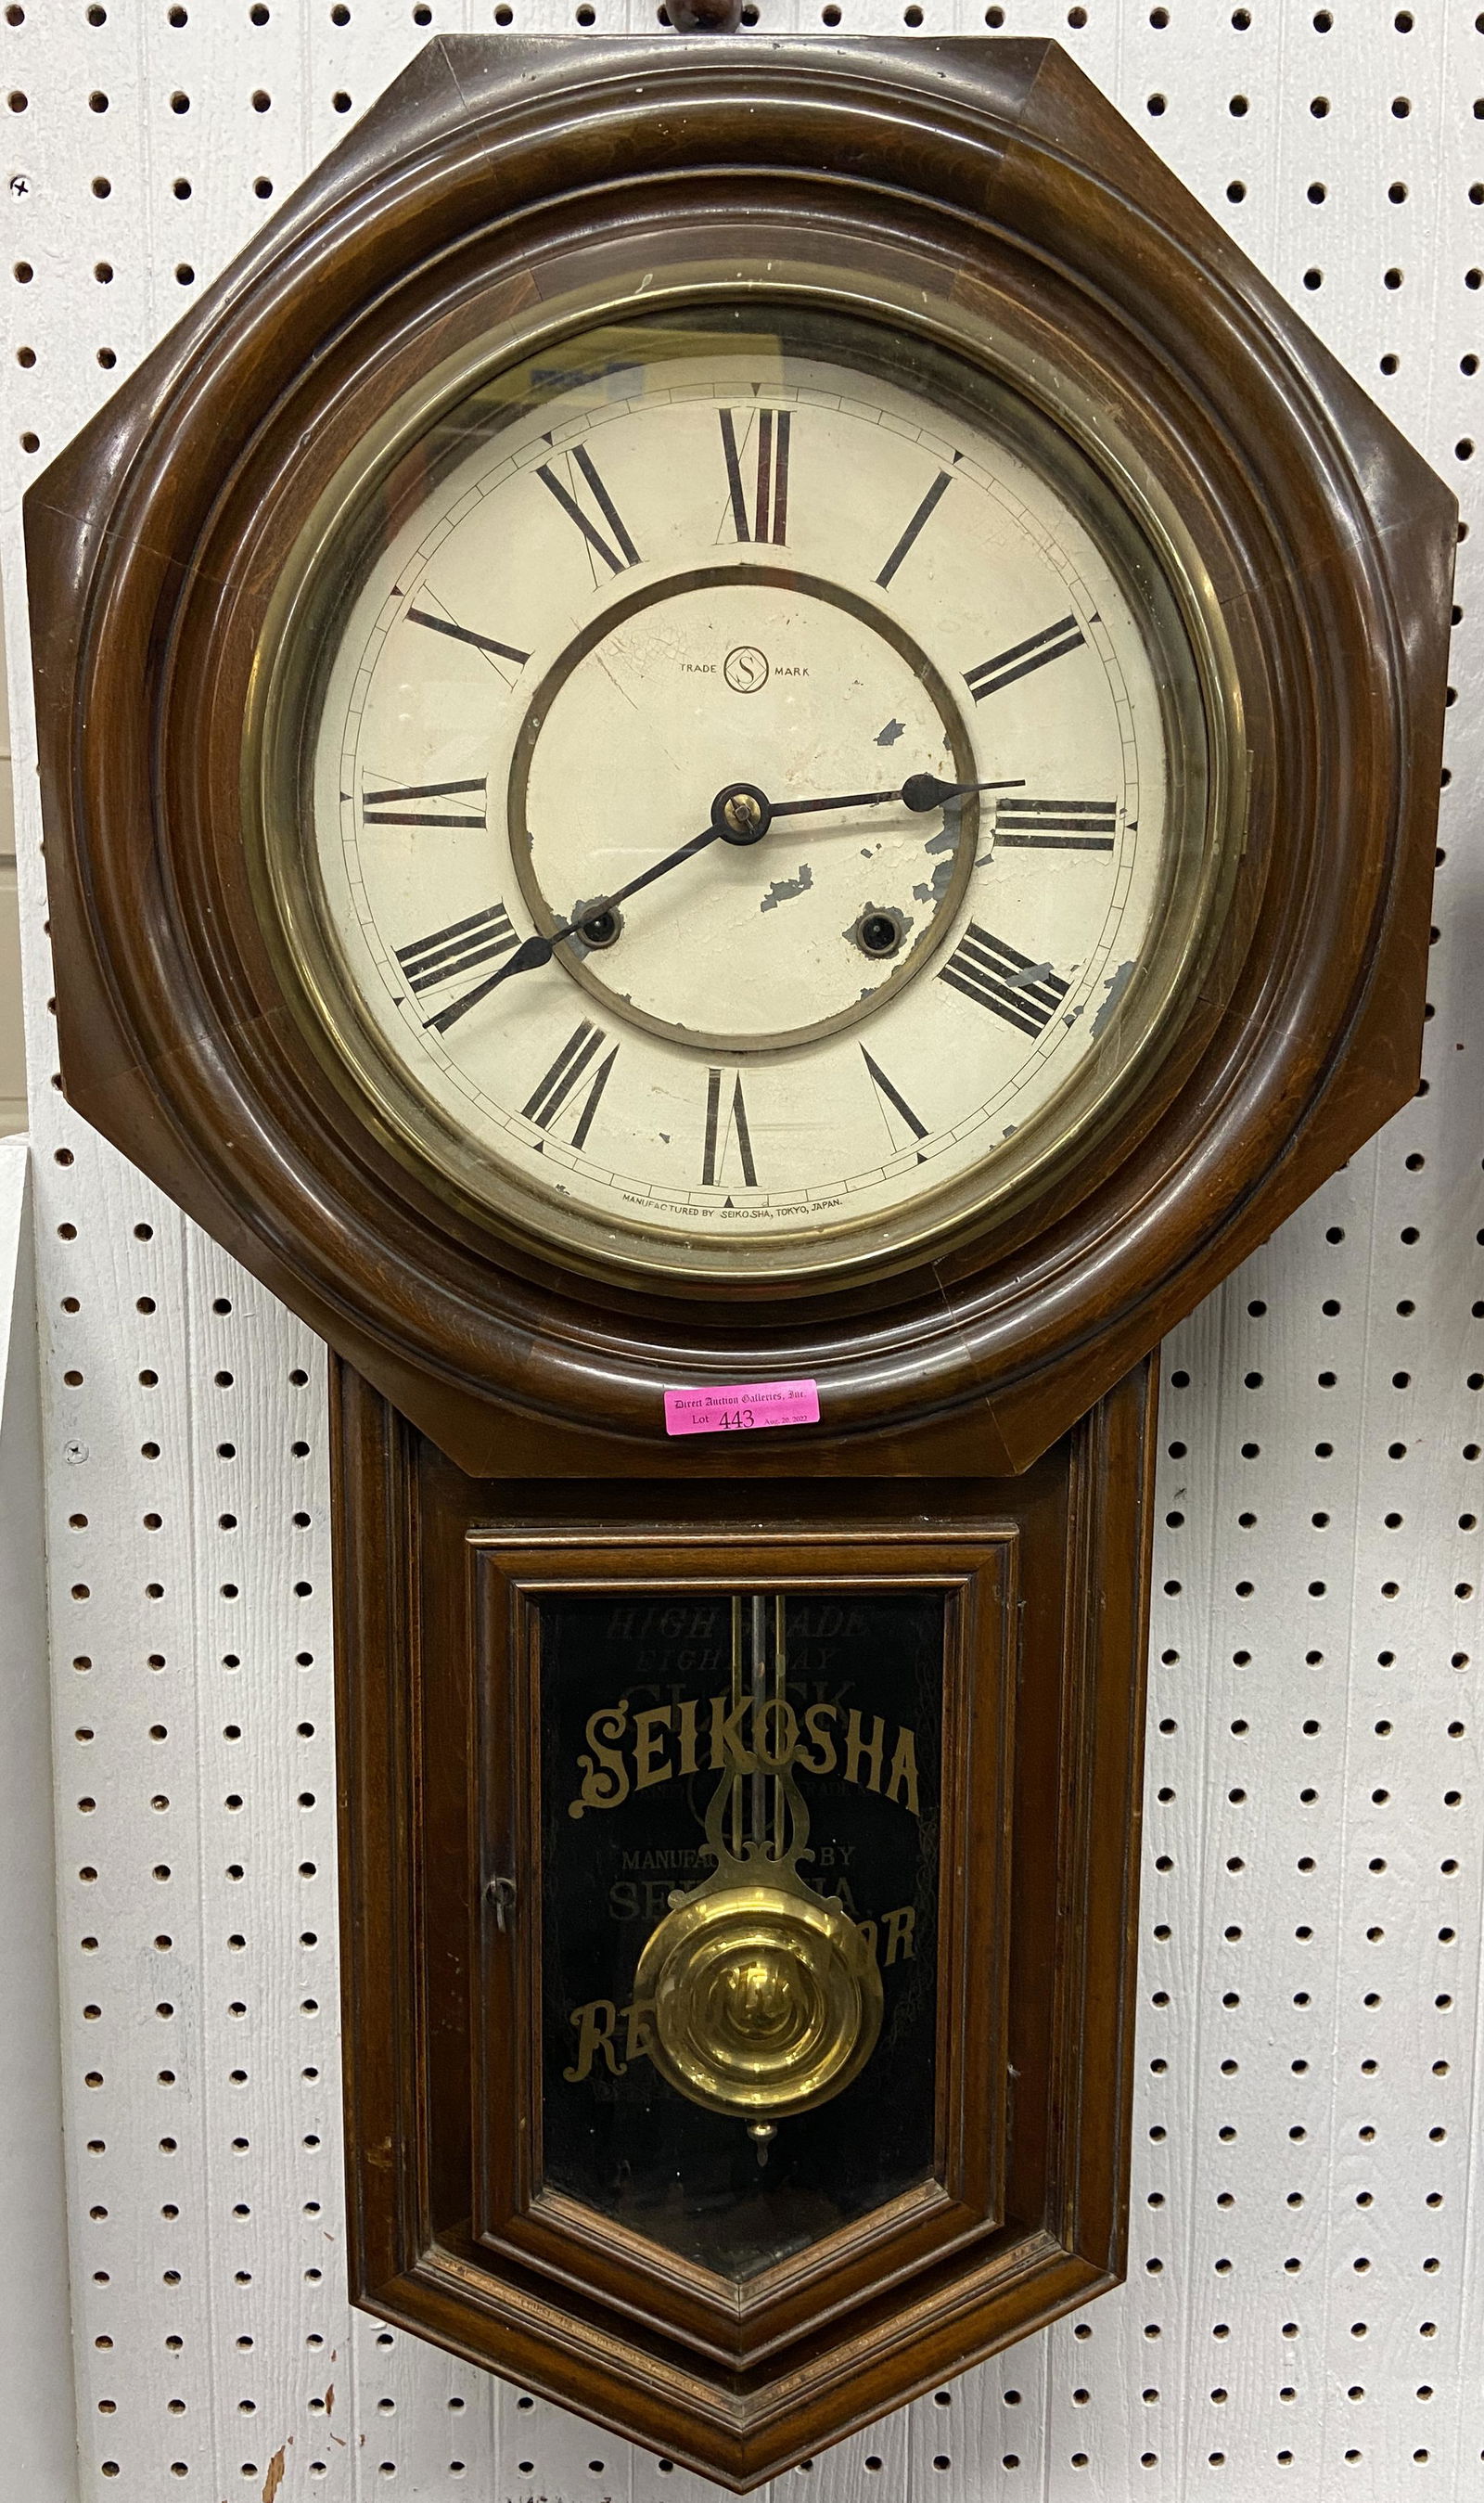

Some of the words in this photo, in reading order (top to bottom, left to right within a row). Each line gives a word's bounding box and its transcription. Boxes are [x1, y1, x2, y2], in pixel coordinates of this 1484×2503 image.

[712, 406, 797, 547] XII
[870, 466, 957, 593] I
[402, 579, 535, 693] X
[680, 663, 717, 674] TRADE
[774, 667, 810, 676] MARK
[959, 605, 1090, 707] II
[992, 795, 1118, 857] III
[932, 916, 1075, 1045] IIII
[859, 1041, 934, 1156] V
[622, 1193, 699, 1217] MANUFACTURED
[702, 1209, 715, 1217] BY
[776, 1204, 810, 1217] TOKYO,
[812, 1198, 843, 1212] JAPAN.
[674, 1399, 702, 1409] Direct
[705, 1396, 739, 1407] Auction
[741, 1392, 786, 1404] Galleries,
[788, 1390, 807, 1399] Inc.
[692, 1415, 710, 1424] Lot
[719, 1409, 755, 1430] 443
[636, 1648, 736, 1673] EIGH
[568, 1694, 920, 1819] SEIKOSHA
[820, 1845, 856, 1867] BY
